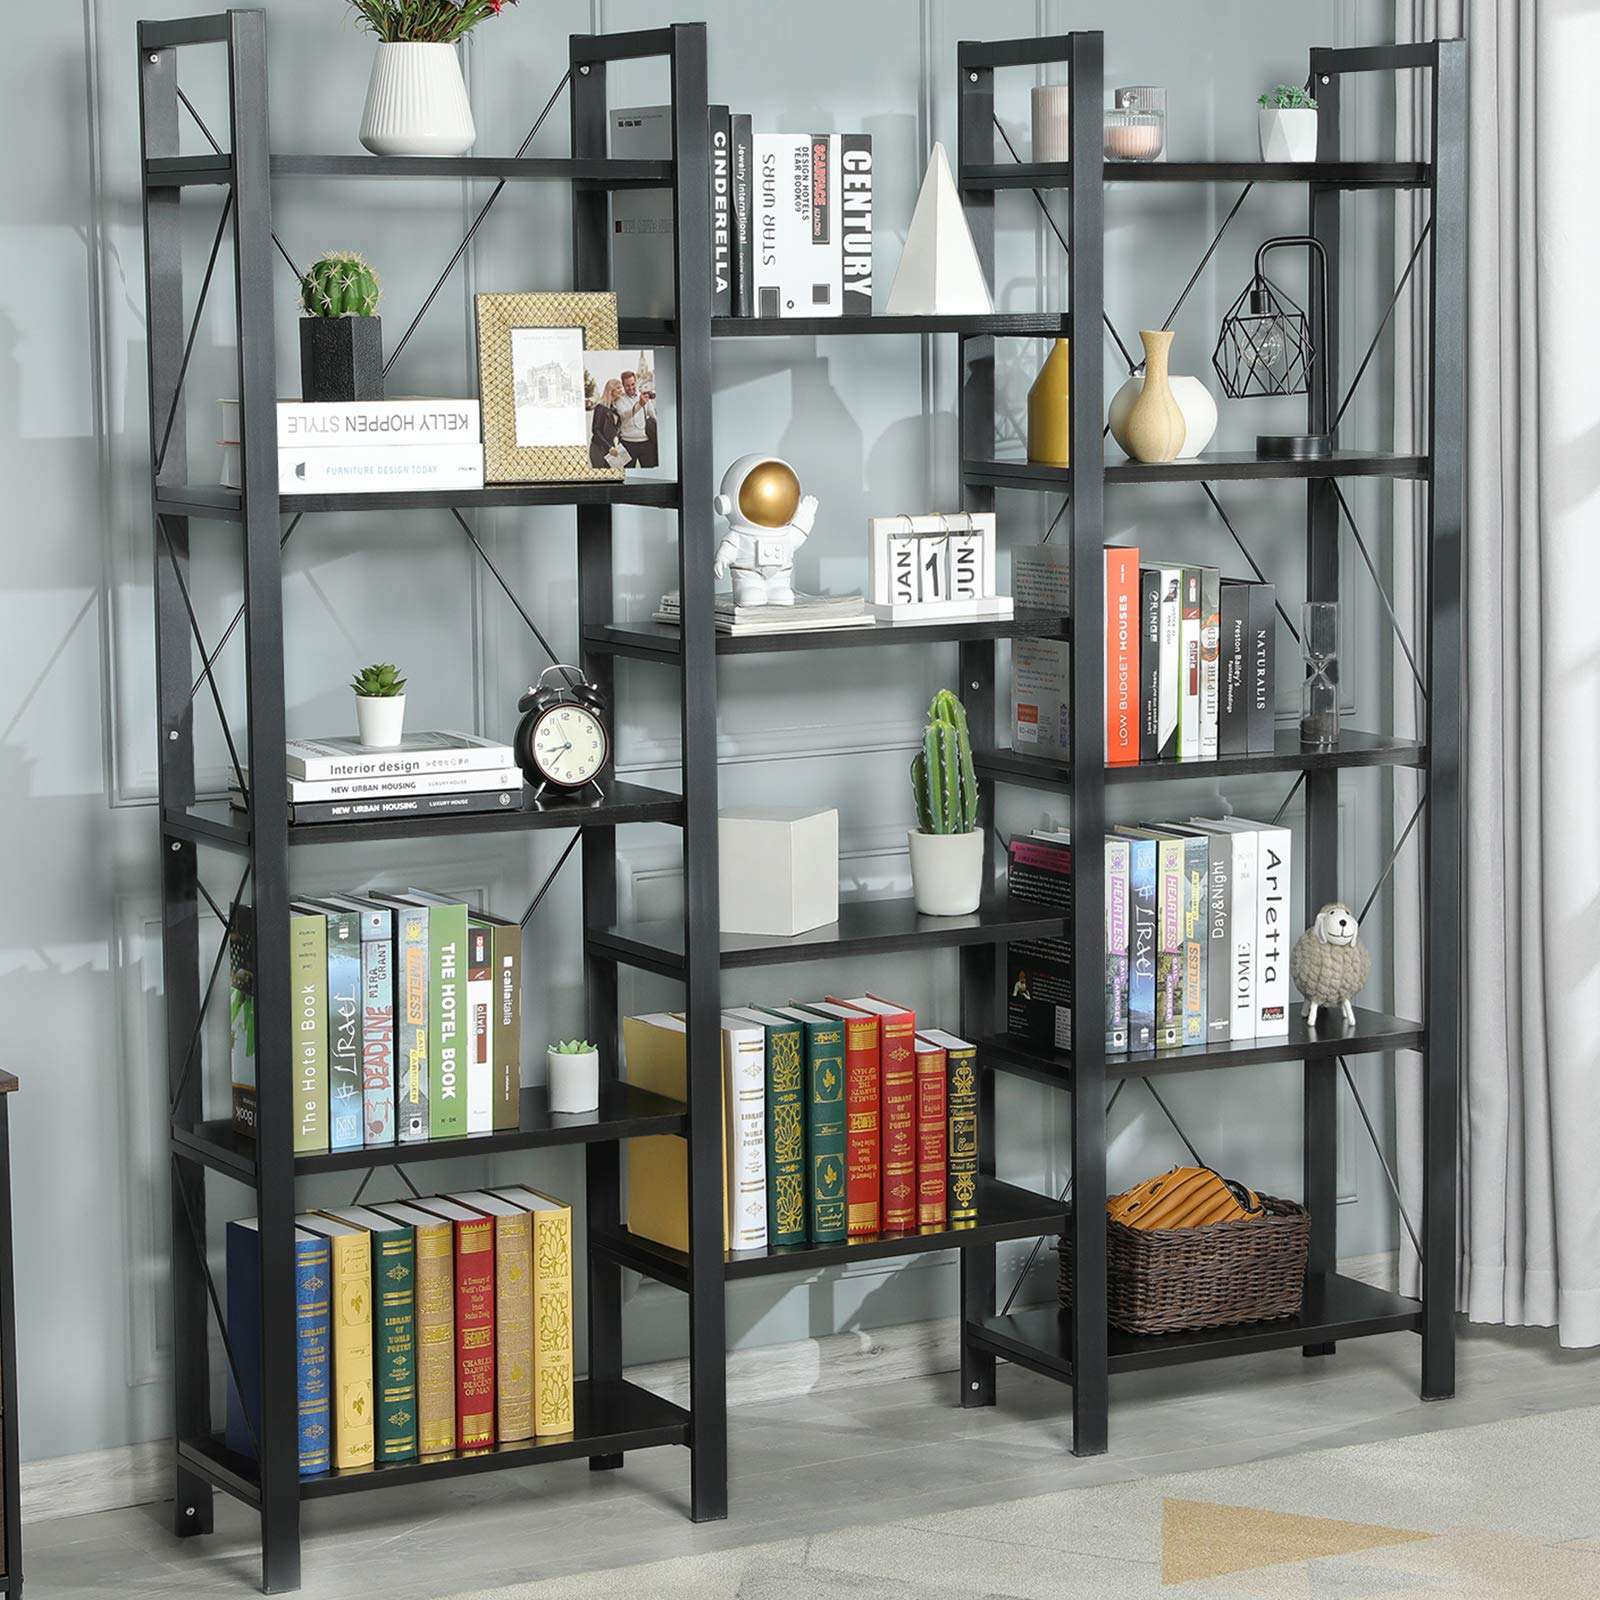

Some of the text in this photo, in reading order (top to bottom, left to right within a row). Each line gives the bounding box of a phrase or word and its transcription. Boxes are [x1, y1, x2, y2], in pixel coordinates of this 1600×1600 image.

[736, 144, 748, 244] Jewelry International
[814, 144, 826, 206] SCARFACE
[713, 131, 729, 293] CINDERELLA
[762, 154, 776, 266] STAR WARS
[842, 151, 872, 297] CENTURY
[287, 414, 469, 433] KELLY HOPPEN STYLE
[326, 465, 438, 475] FURNITURE DESIGN TODAY
[897, 551, 912, 604] JAN
[925, 552, 939, 597] 1
[957, 548, 975, 599] JUN
[1119, 594, 1128, 746] LOW BUDGET HOUSES
[1233, 619, 1242, 687] Preston Bailey's
[1257, 630, 1266, 710] NATURALIS
[586, 726, 593, 734] 2
[592, 741, 598, 749] 3
[330, 763, 376, 775] Interior
[378, 760, 420, 775] design
[330, 782, 416, 794] NEW URBAN HOUSING
[566, 771, 572, 779] 6
[332, 801, 418, 816] NEW URBAN HOUSING
[1111, 879, 1123, 951] HEARTLESS
[1165, 876, 1177, 948] HEARTLESS
[1212, 860, 1227, 939] Day&Night
[1264, 849, 1282, 983] Arletta
[368, 967, 378, 999] MIRA
[377, 943, 387, 980] GRANT
[1237, 942, 1250, 1009] HOME
[300, 983, 316, 1031] Book
[441, 942, 456, 1100] THE HOTEL BOOK
[301, 1040, 316, 1091] Hotel
[363, 1006, 393, 1090] DEADLINE
[301, 1101, 317, 1136] The
